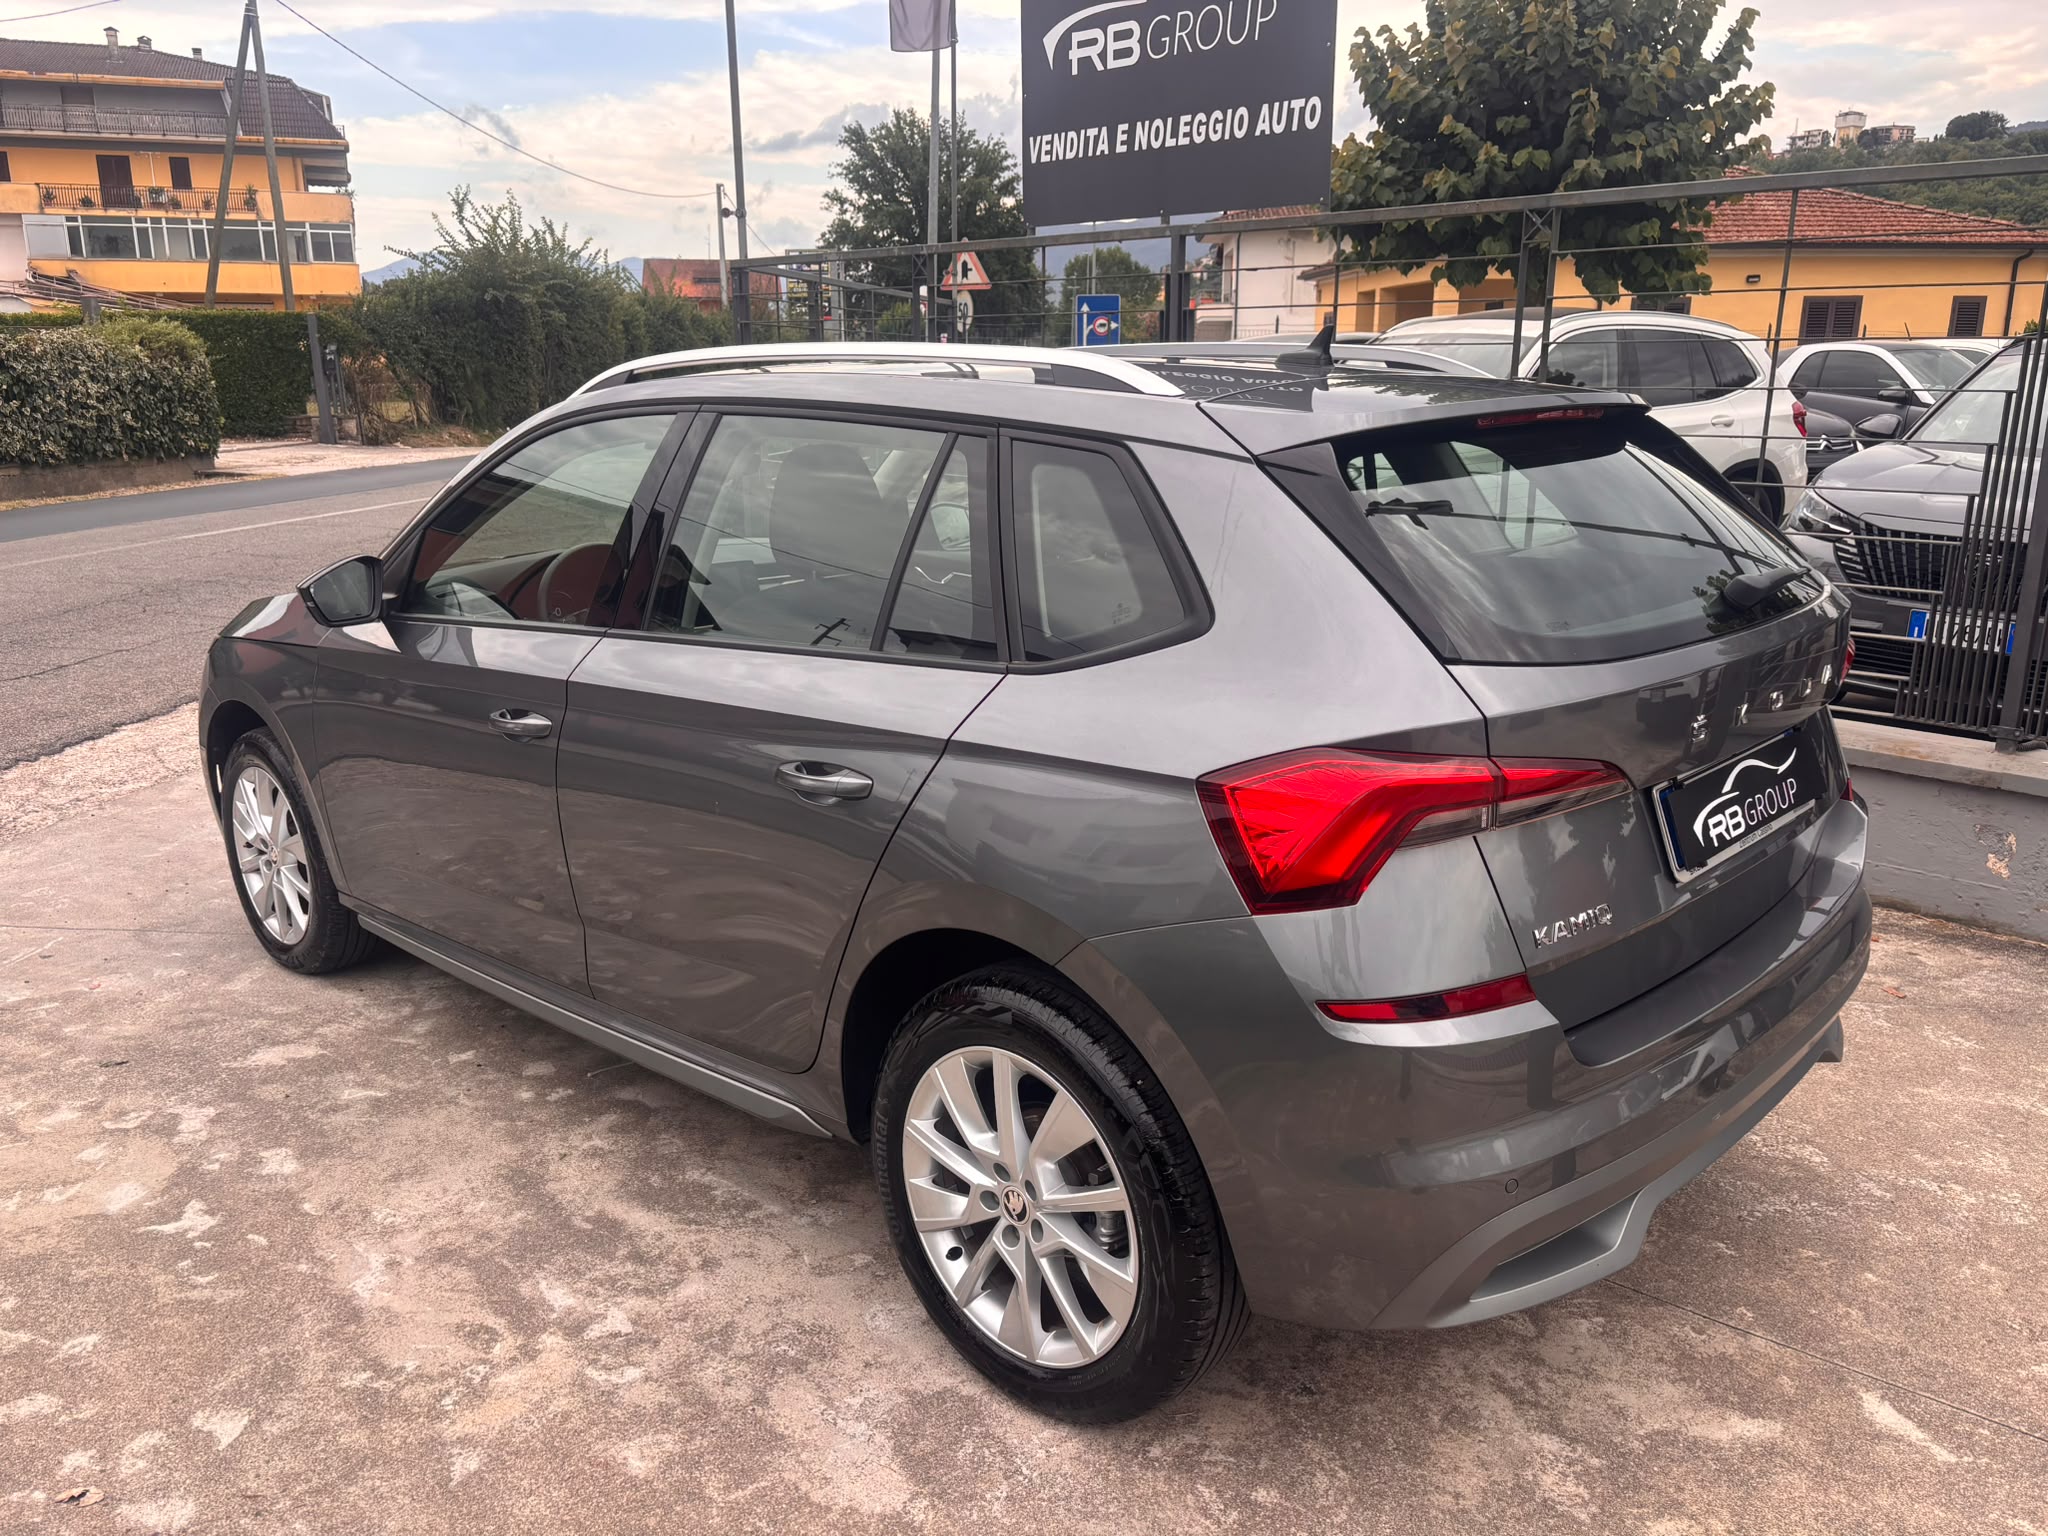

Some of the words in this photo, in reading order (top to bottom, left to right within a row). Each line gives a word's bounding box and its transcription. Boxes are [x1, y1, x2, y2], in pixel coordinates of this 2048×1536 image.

[1029, 126, 1109, 164] VENDITA
[1115, 123, 1129, 154] E
[1134, 106, 1249, 151] NOLEGGIO
[1254, 95, 1322, 137] AUTO
[958, 302, 969, 321] 50
[1532, 903, 1613, 949] KAMIQ
